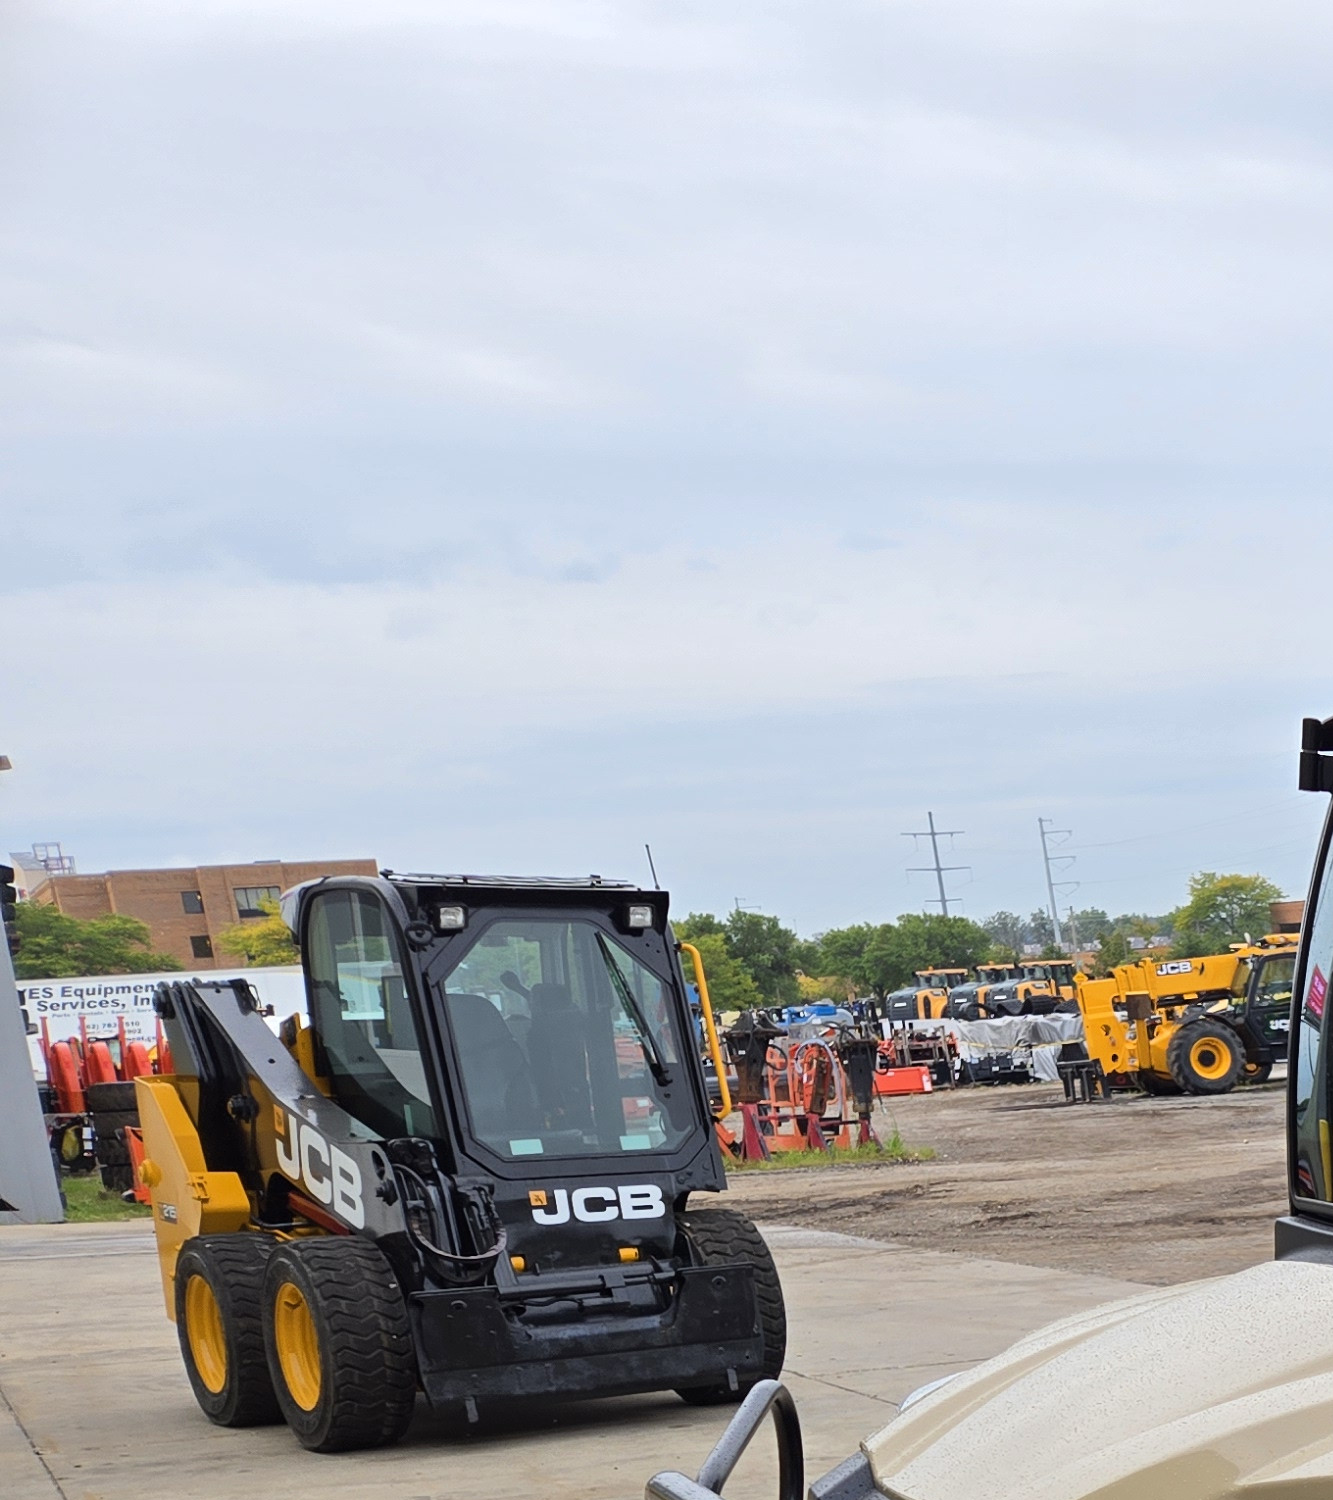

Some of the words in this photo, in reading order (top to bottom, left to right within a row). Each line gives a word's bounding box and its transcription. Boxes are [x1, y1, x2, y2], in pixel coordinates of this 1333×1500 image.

[1157, 961, 1193, 976] JCB
[61, 983, 157, 1000] Equipmen
[37, 998, 126, 1012] Services,
[134, 995, 151, 1006] In
[275, 1113, 365, 1231] JCB
[531, 1184, 666, 1226] JCB
